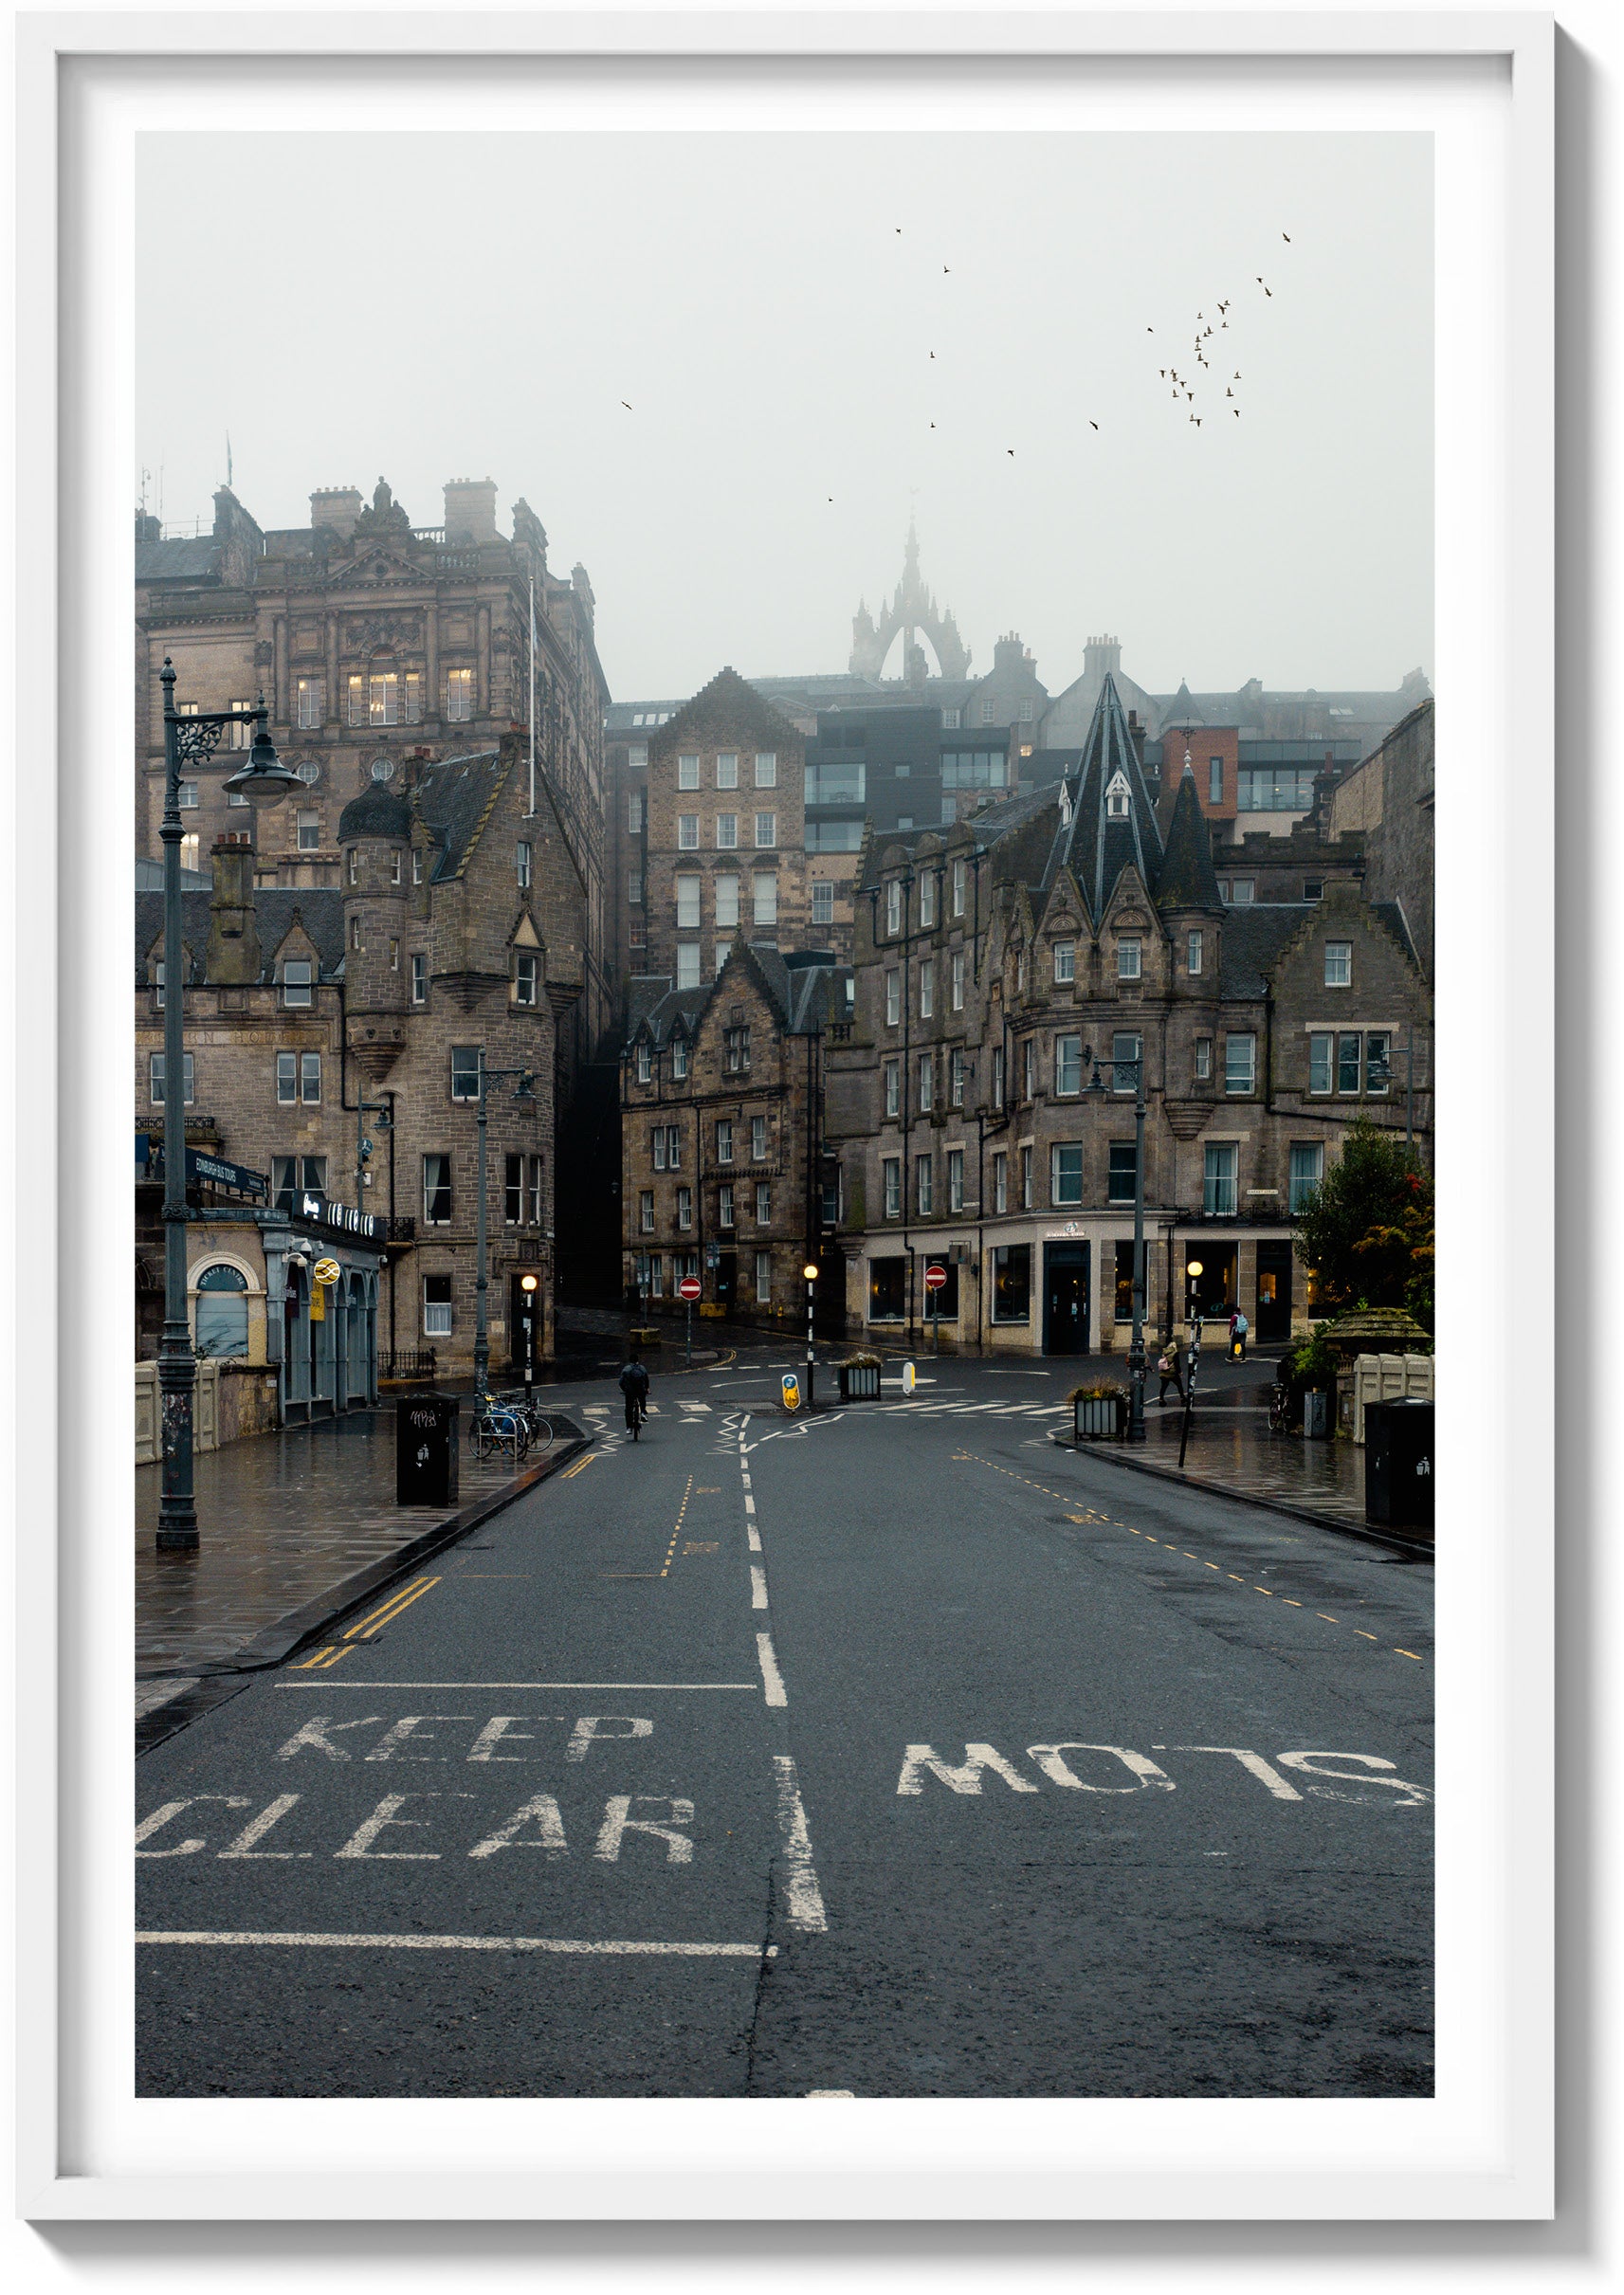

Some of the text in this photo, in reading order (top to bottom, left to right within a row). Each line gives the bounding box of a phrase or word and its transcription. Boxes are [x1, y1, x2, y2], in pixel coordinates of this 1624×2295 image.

[195, 1157, 217, 1176] EDINBURGH
[225, 1167, 236, 1183] TOURS
[200, 1266, 220, 1286] TICKET
[273, 1716, 655, 1762] KEEP
[897, 1742, 1434, 1806] SLOW
[135, 1794, 696, 1863] CLEAR
